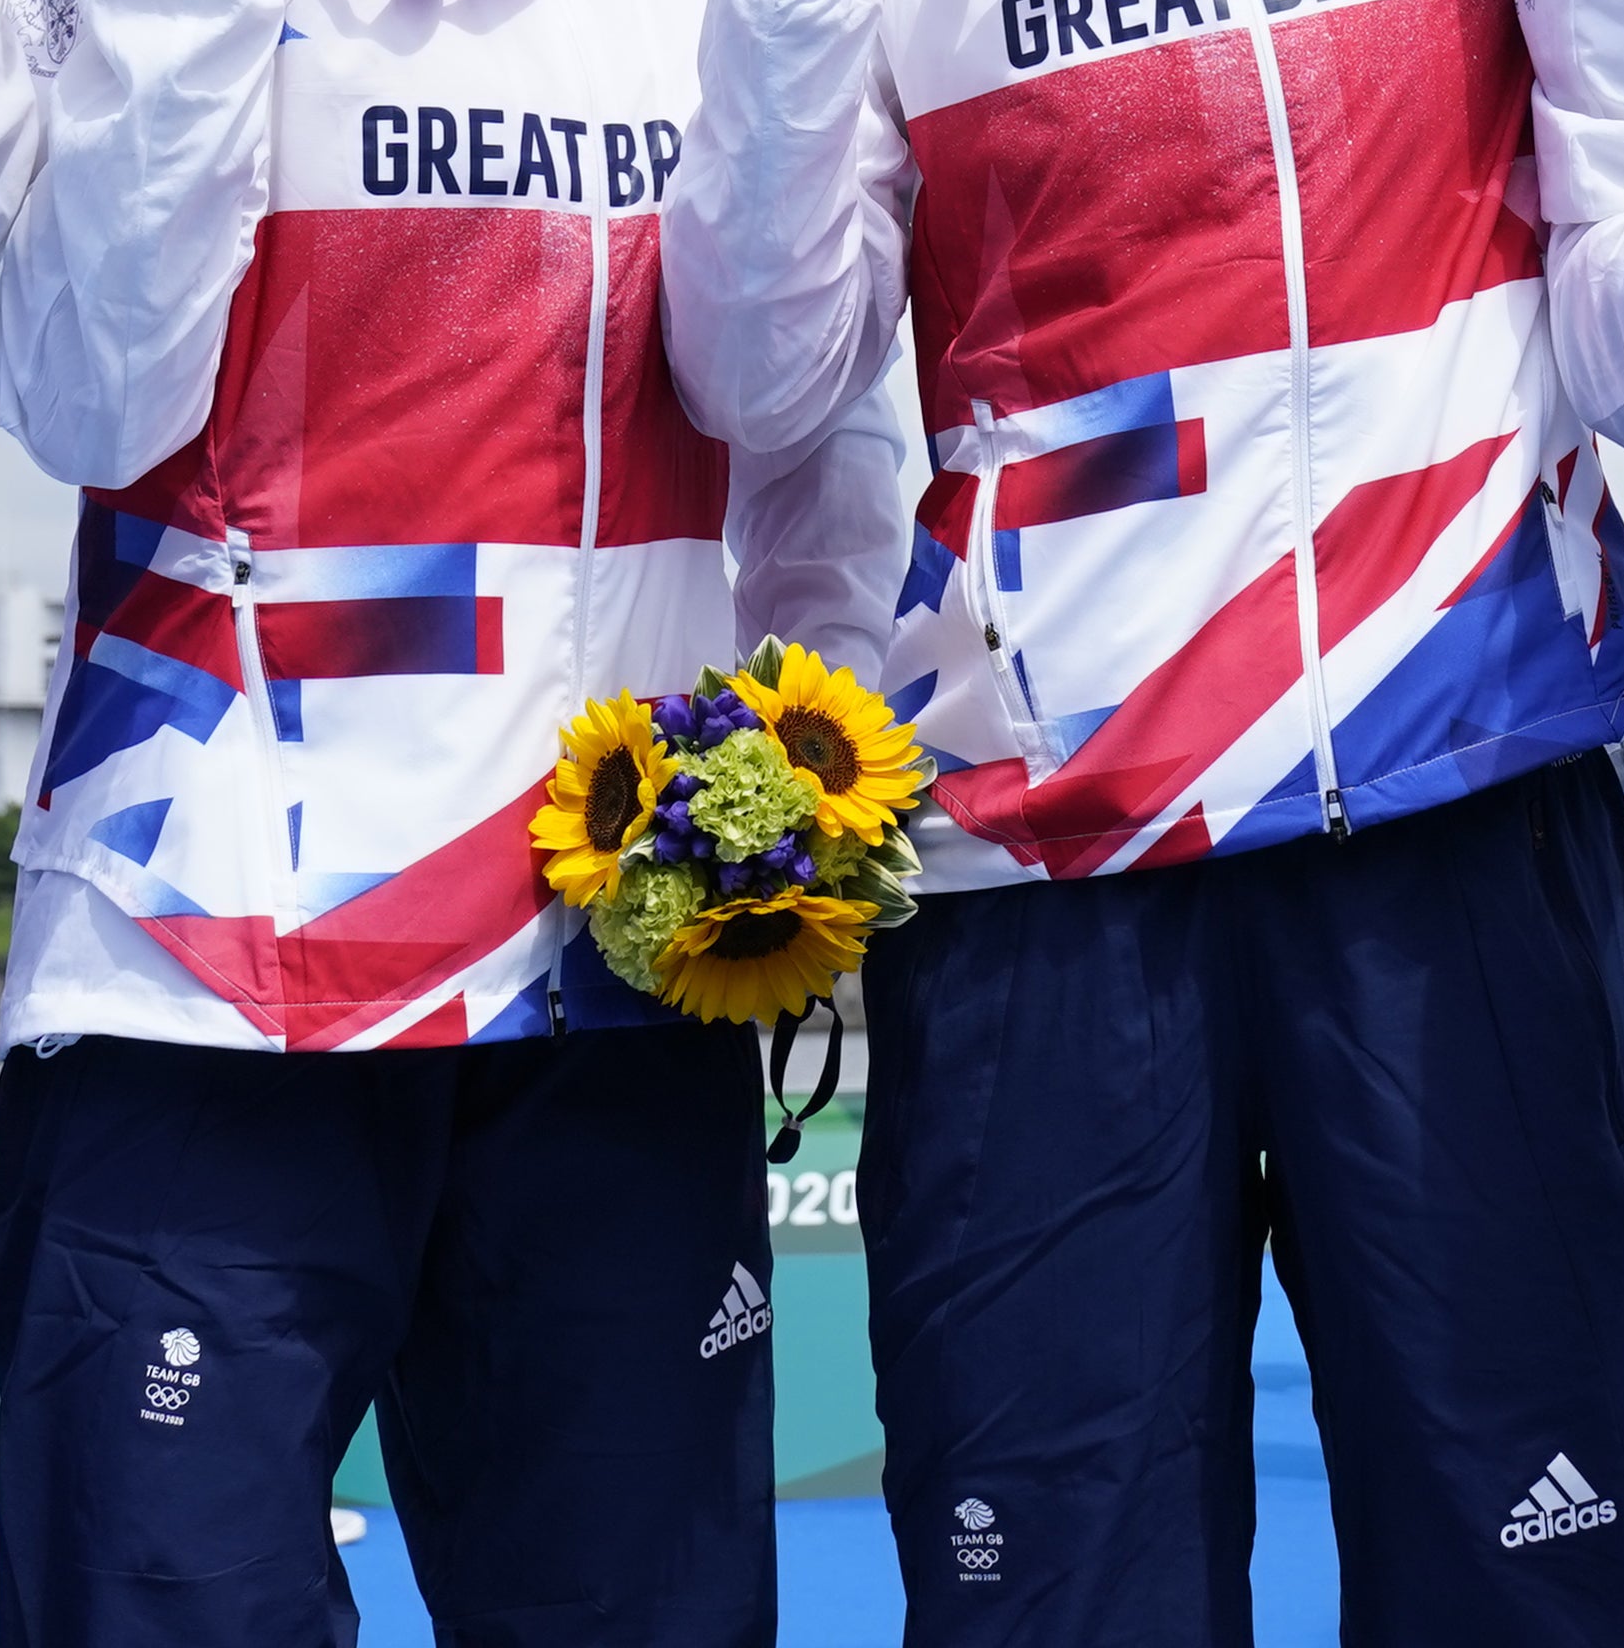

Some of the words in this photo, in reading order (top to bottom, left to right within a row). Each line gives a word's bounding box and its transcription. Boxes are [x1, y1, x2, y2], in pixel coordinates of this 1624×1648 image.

[362, 105, 587, 203] GREAT
[767, 1170, 859, 1227] 020
[700, 1303, 771, 1359] adidas
[146, 1365, 180, 1383] TEAM
[182, 1373, 201, 1387] GB
[140, 1409, 164, 1423] TOKYO
[165, 1415, 184, 1426] 2020
[950, 1534, 983, 1546] TEAM
[986, 1533, 1004, 1545] GB
[1500, 1496, 1617, 1549] adidas
